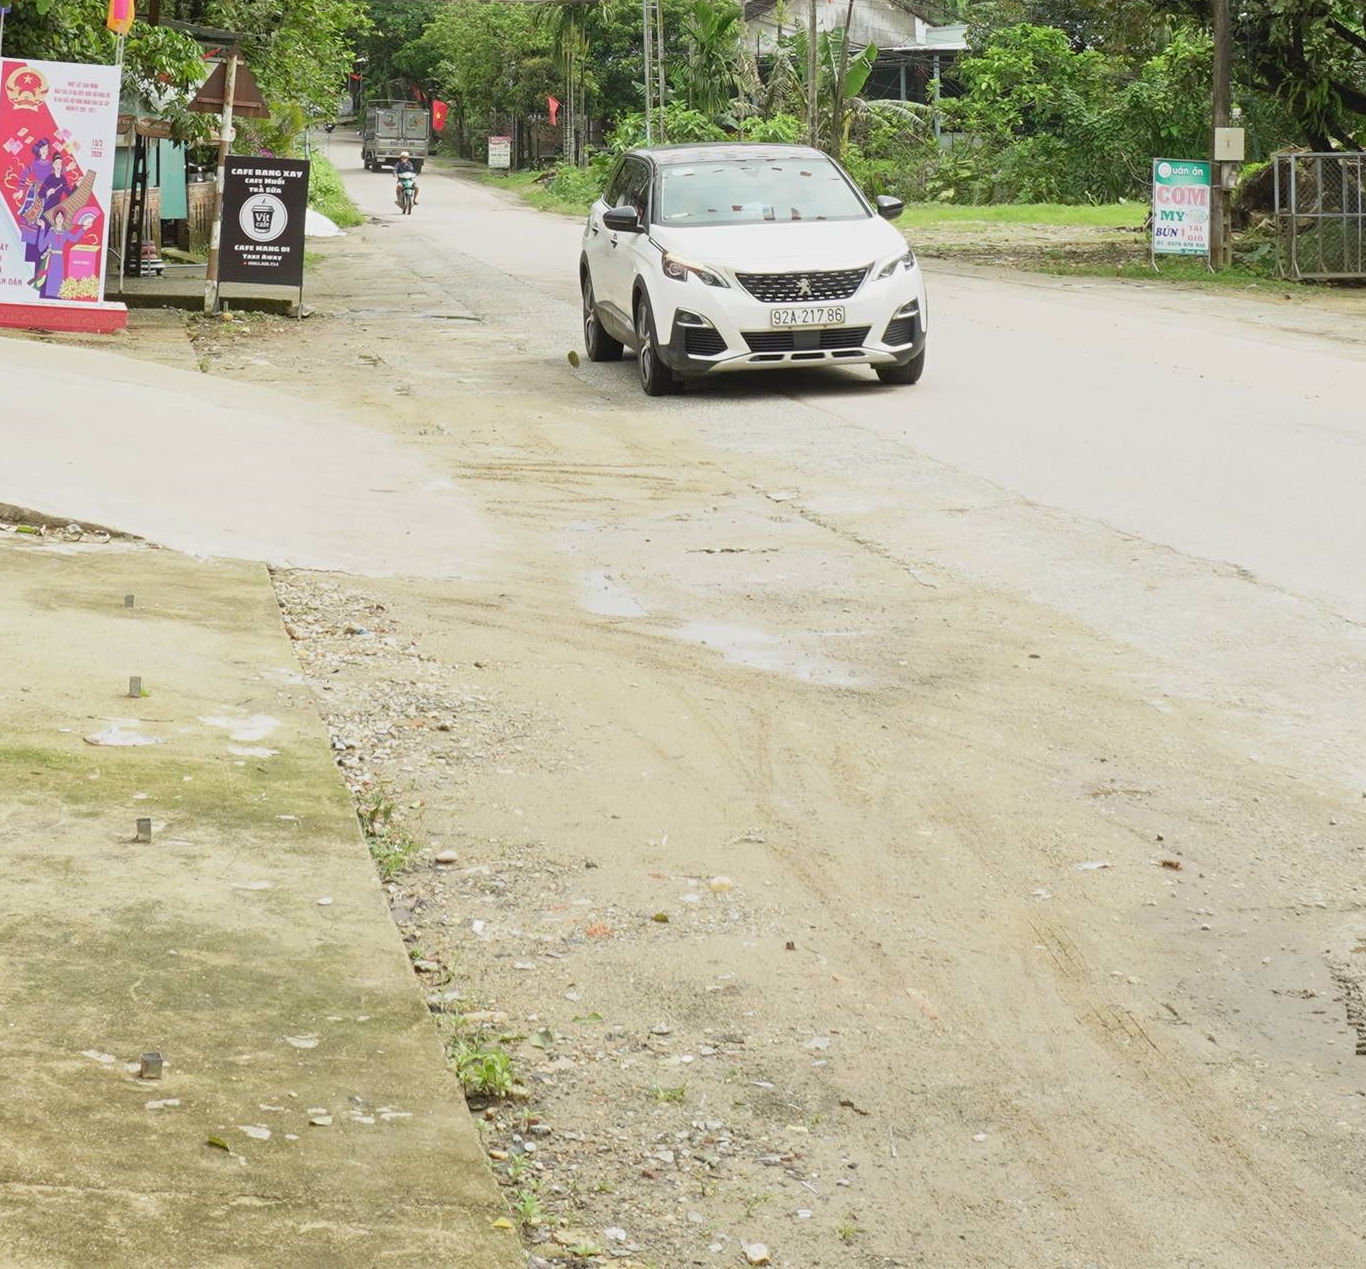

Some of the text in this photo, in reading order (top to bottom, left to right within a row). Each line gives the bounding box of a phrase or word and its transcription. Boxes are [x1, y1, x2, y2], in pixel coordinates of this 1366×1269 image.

[231, 168, 303, 178] CAFE RANG XAY
[256, 220, 270, 228] cafe
